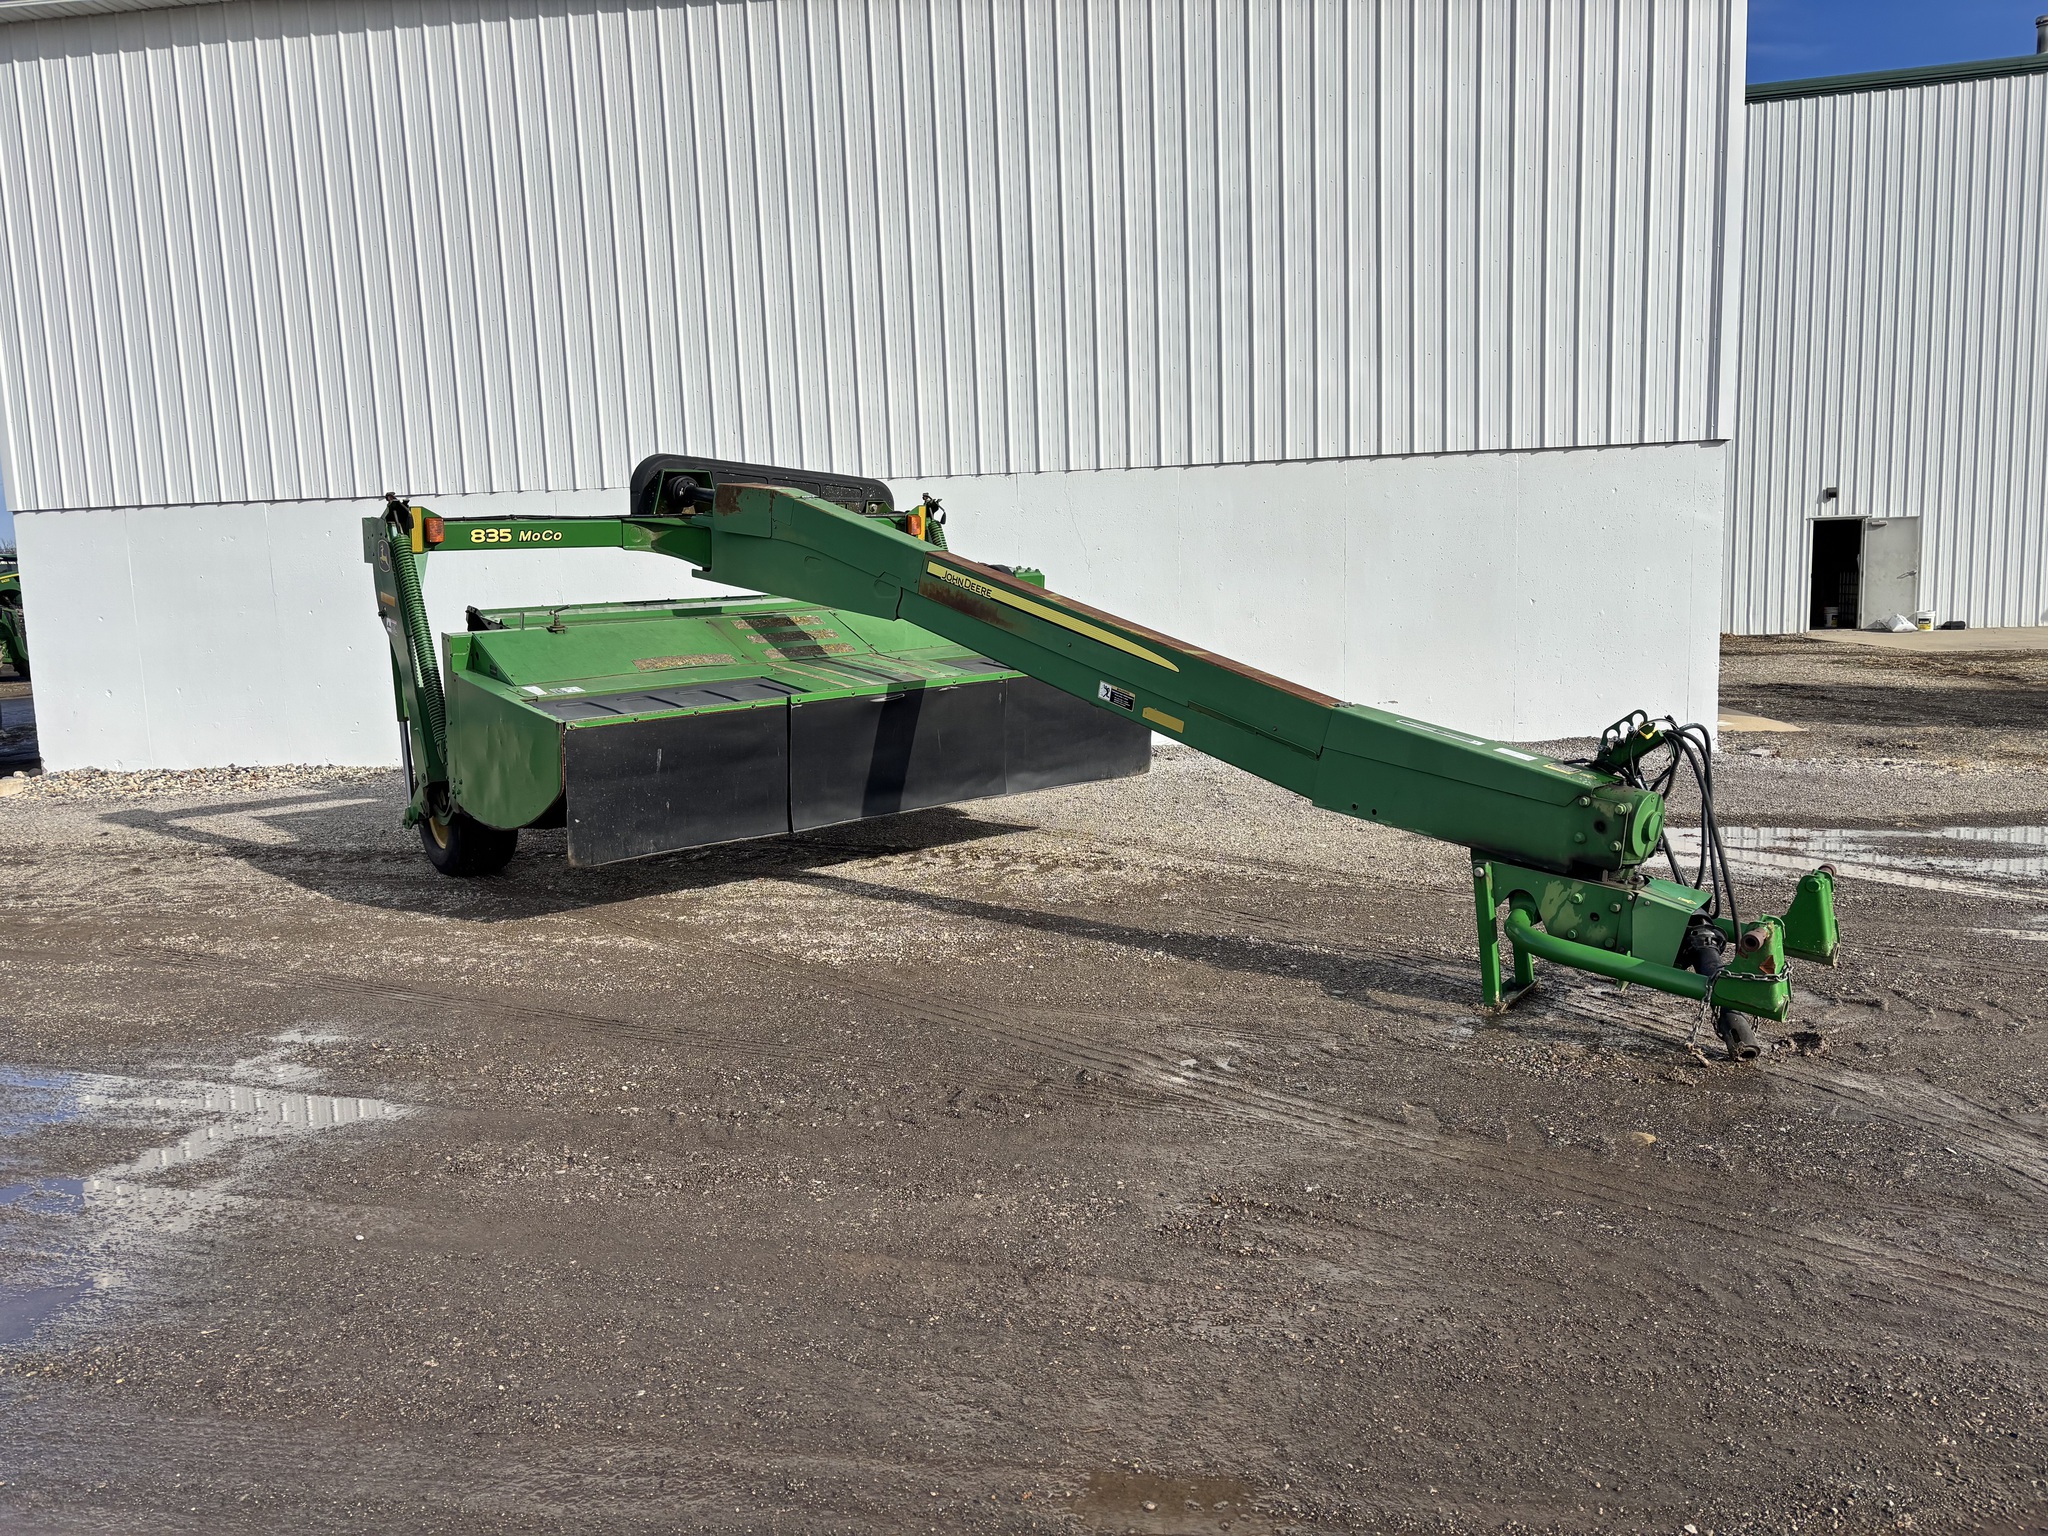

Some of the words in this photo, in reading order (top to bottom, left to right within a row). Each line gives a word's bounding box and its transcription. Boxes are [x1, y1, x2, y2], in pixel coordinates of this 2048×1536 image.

[470, 528, 512, 543] 835
[518, 529, 562, 542] MoCo
[941, 570, 964, 587] JOHN
[964, 578, 992, 597] DEERE
